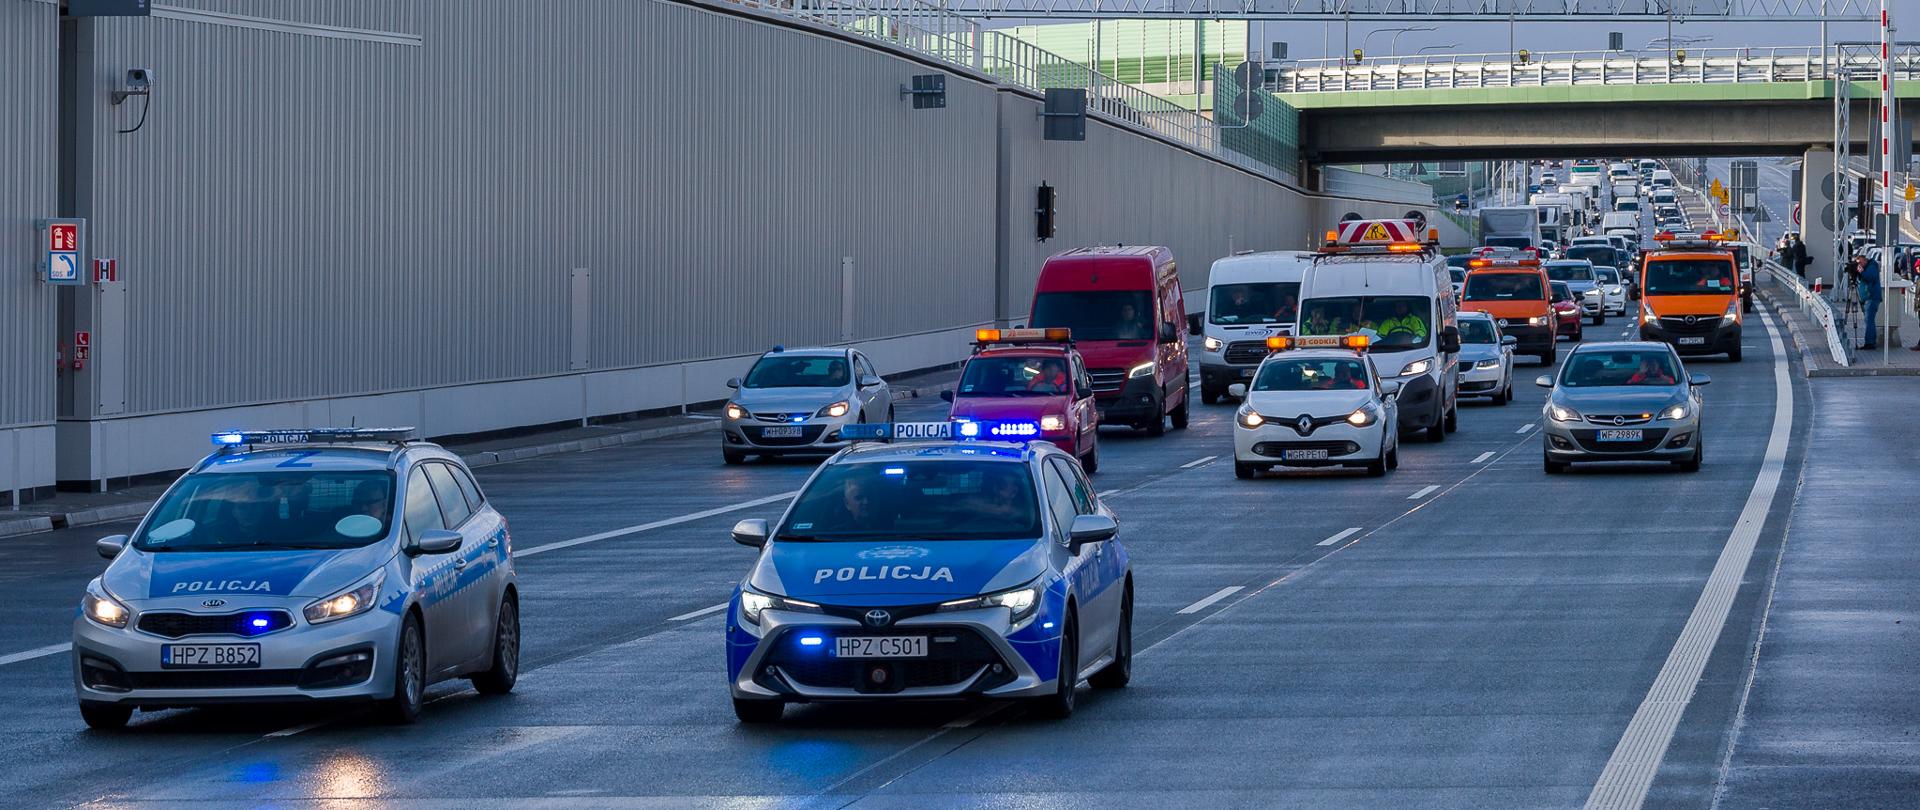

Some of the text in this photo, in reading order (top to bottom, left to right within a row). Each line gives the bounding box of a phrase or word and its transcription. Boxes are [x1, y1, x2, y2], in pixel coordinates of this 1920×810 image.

[52, 270, 63, 278] SOS
[100, 261, 109, 280] H
[896, 423, 949, 438] POLICJA
[1601, 430, 1641, 439] WF 2989K
[262, 434, 308, 443] POLICJA
[1286, 450, 1327, 459] WGR PE10
[814, 565, 954, 585] POLICJA
[172, 580, 272, 593] POLICJA
[839, 638, 873, 657] HPZ
[880, 637, 921, 656] C501
[173, 647, 209, 664] HPZ
[215, 646, 257, 664] B852
